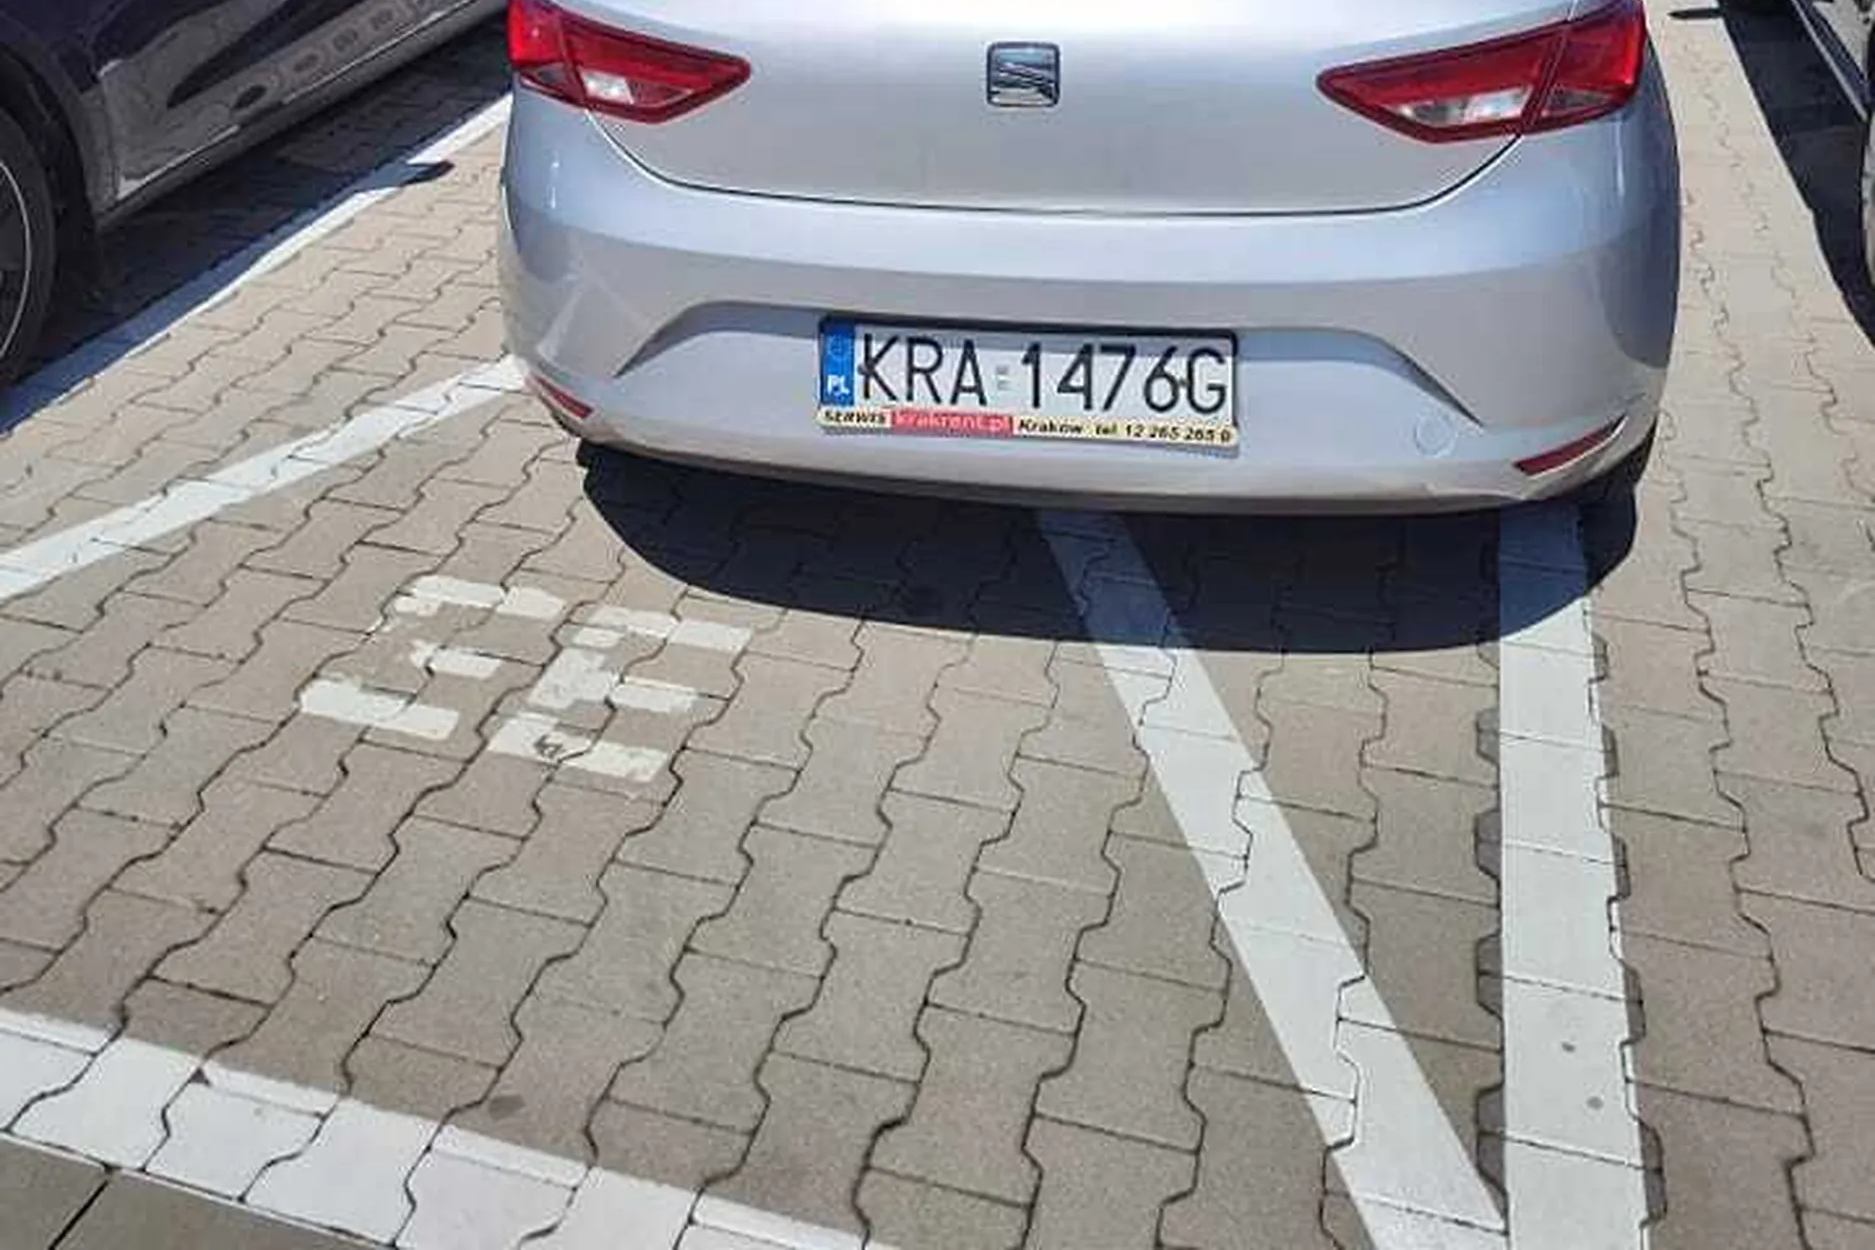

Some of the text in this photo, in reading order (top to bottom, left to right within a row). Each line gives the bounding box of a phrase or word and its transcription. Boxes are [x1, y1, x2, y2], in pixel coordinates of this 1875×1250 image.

[827, 375, 850, 395] PL
[863, 333, 1228, 414] KRA 1476G
